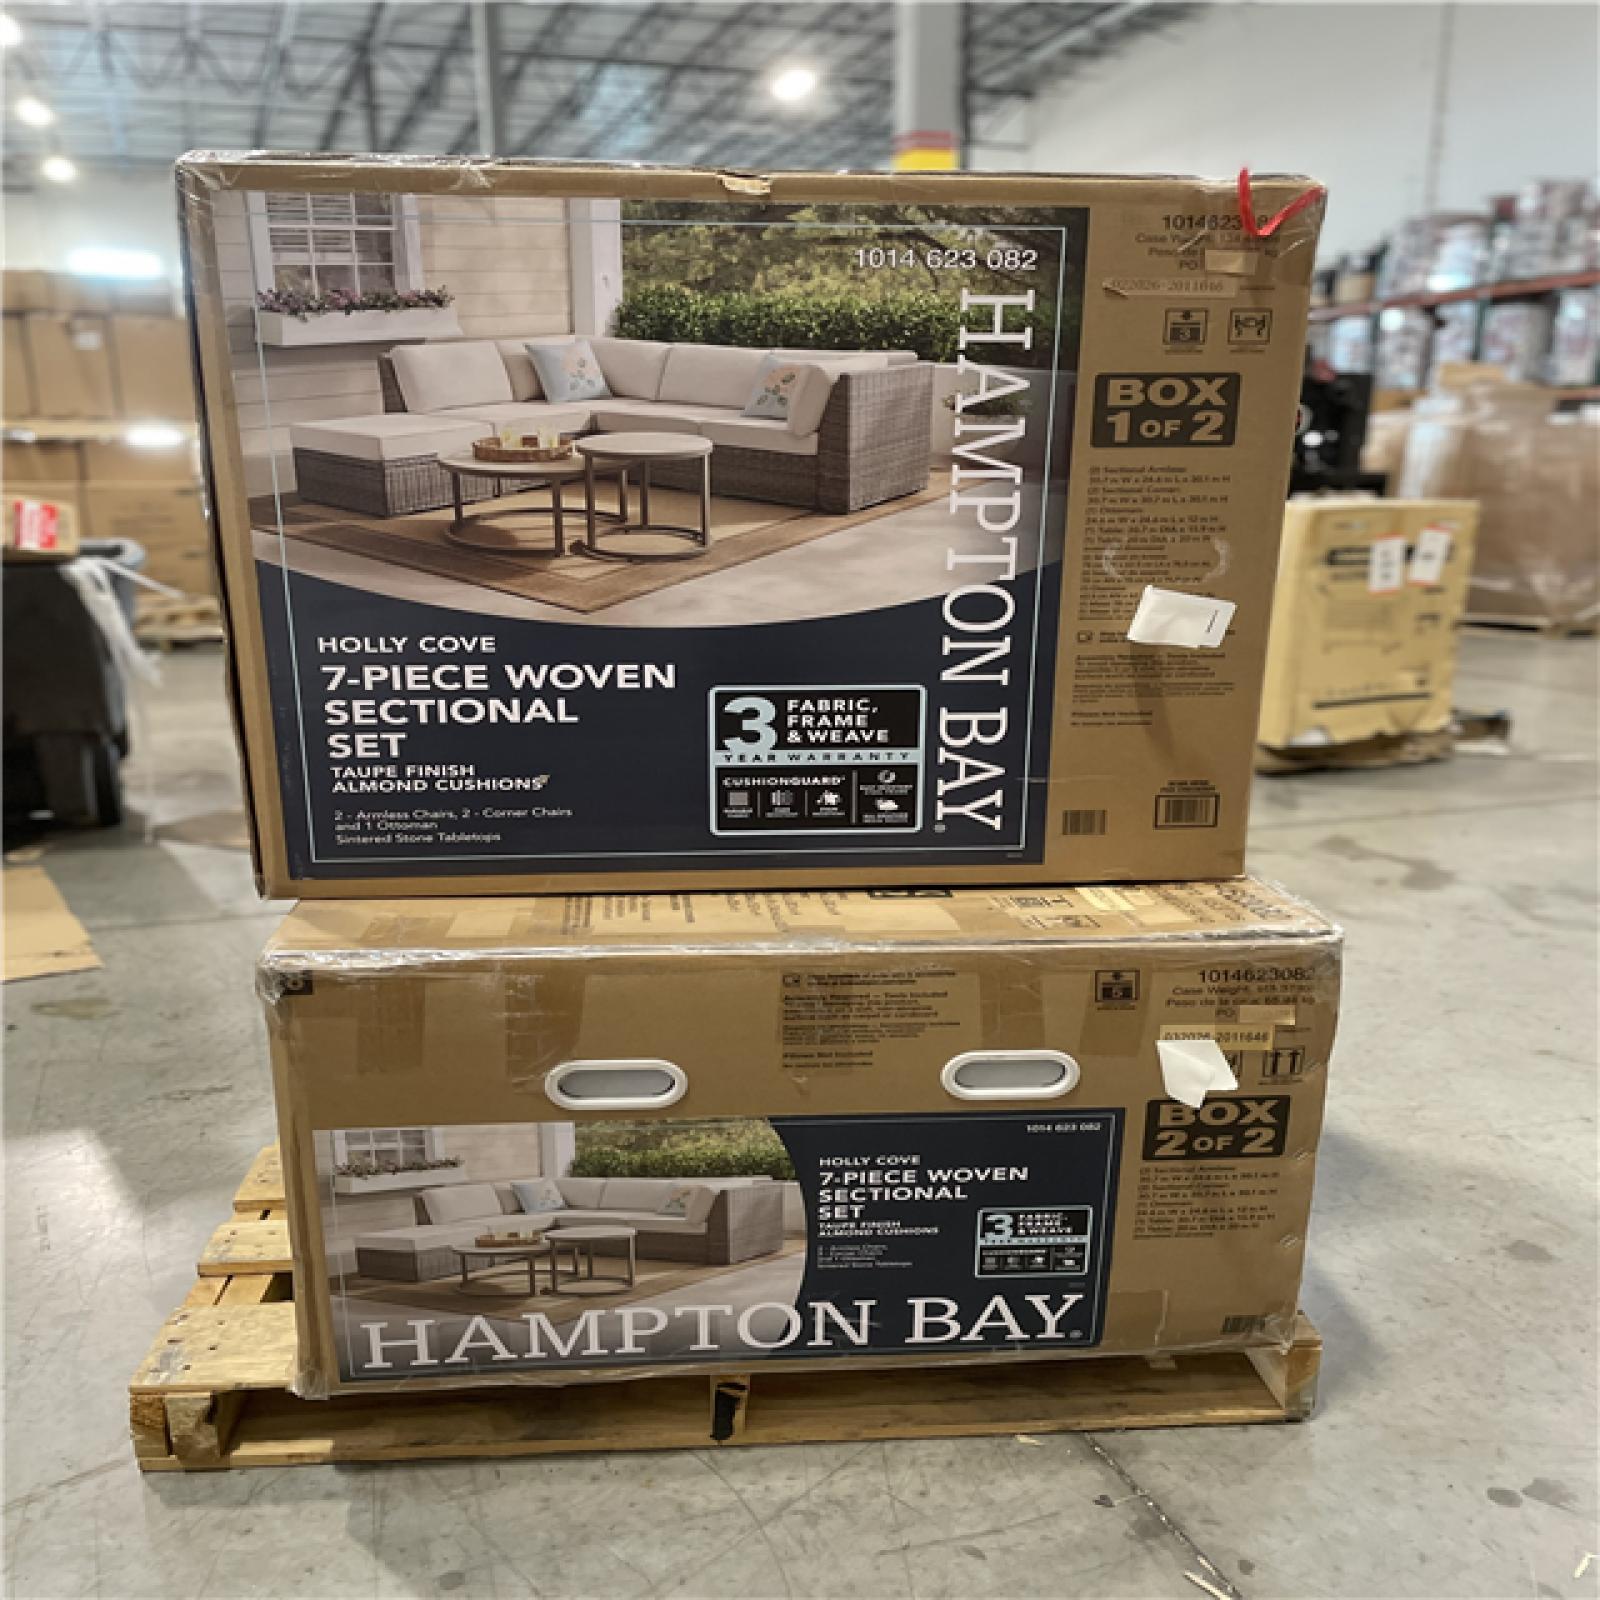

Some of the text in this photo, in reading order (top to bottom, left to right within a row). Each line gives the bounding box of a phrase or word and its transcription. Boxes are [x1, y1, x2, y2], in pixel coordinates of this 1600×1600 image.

[854, 248, 1038, 271] 1014 623 082
[1107, 378, 1229, 406] BOX
[1107, 410, 1224, 443] 1 OF 2
[936, 289, 1036, 831] HAMPTON BAY
[317, 636, 497, 654] HOLLY COVE
[320, 663, 677, 691] 7-PIECE WOVEN
[324, 697, 579, 726] SECTIONAL
[787, 698, 879, 713] FABRIC,
[724, 696, 777, 751] 3
[787, 714, 869, 728] FRAME
[327, 731, 407, 758] SET
[786, 729, 889, 743] & WEAVE
[330, 764, 475, 779] TAUPE FINISH
[332, 777, 544, 794] ALMOND CUSHIONS
[532, 806, 573, 818] Chairs
[334, 821, 361, 831] and
[394, 832, 433, 843] Stone
[1159, 1099, 1279, 1126] BOX
[1155, 1127, 1277, 1156] 2 OF 2
[819, 1155, 921, 1167] HOLLY COVE
[819, 1167, 1029, 1186] 7-PIECE WOVEN
[819, 1185, 968, 1204] SECTIONAL
[818, 1204, 866, 1220] SET
[985, 1214, 1014, 1242] 3
[360, 1294, 1083, 1369] HAMPTON BAY
